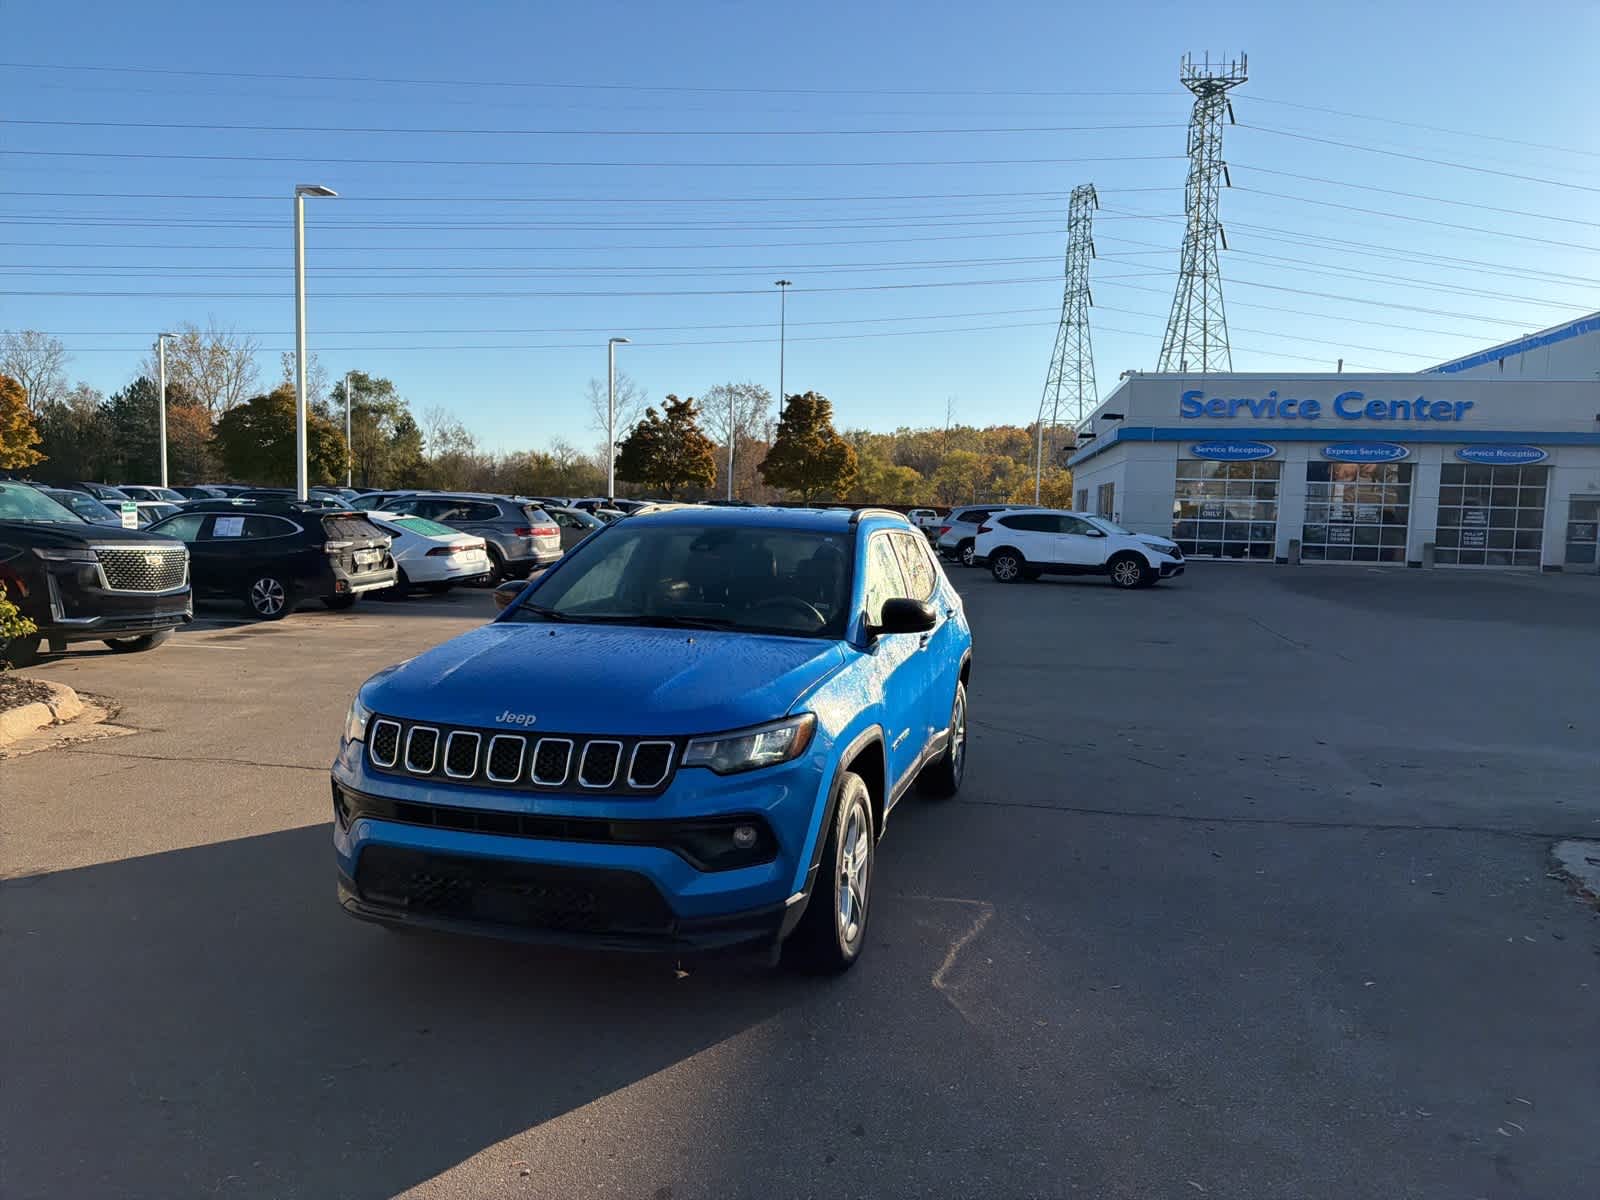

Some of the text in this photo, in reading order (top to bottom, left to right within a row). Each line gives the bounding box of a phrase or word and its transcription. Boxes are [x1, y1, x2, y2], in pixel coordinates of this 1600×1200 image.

[1181, 390, 1474, 422] Service Center
[1195, 446, 1270, 455] Service Reception
[1326, 448, 1390, 456] Express Service
[1462, 449, 1541, 458] Service Reception
[495, 710, 537, 727] Jeep
